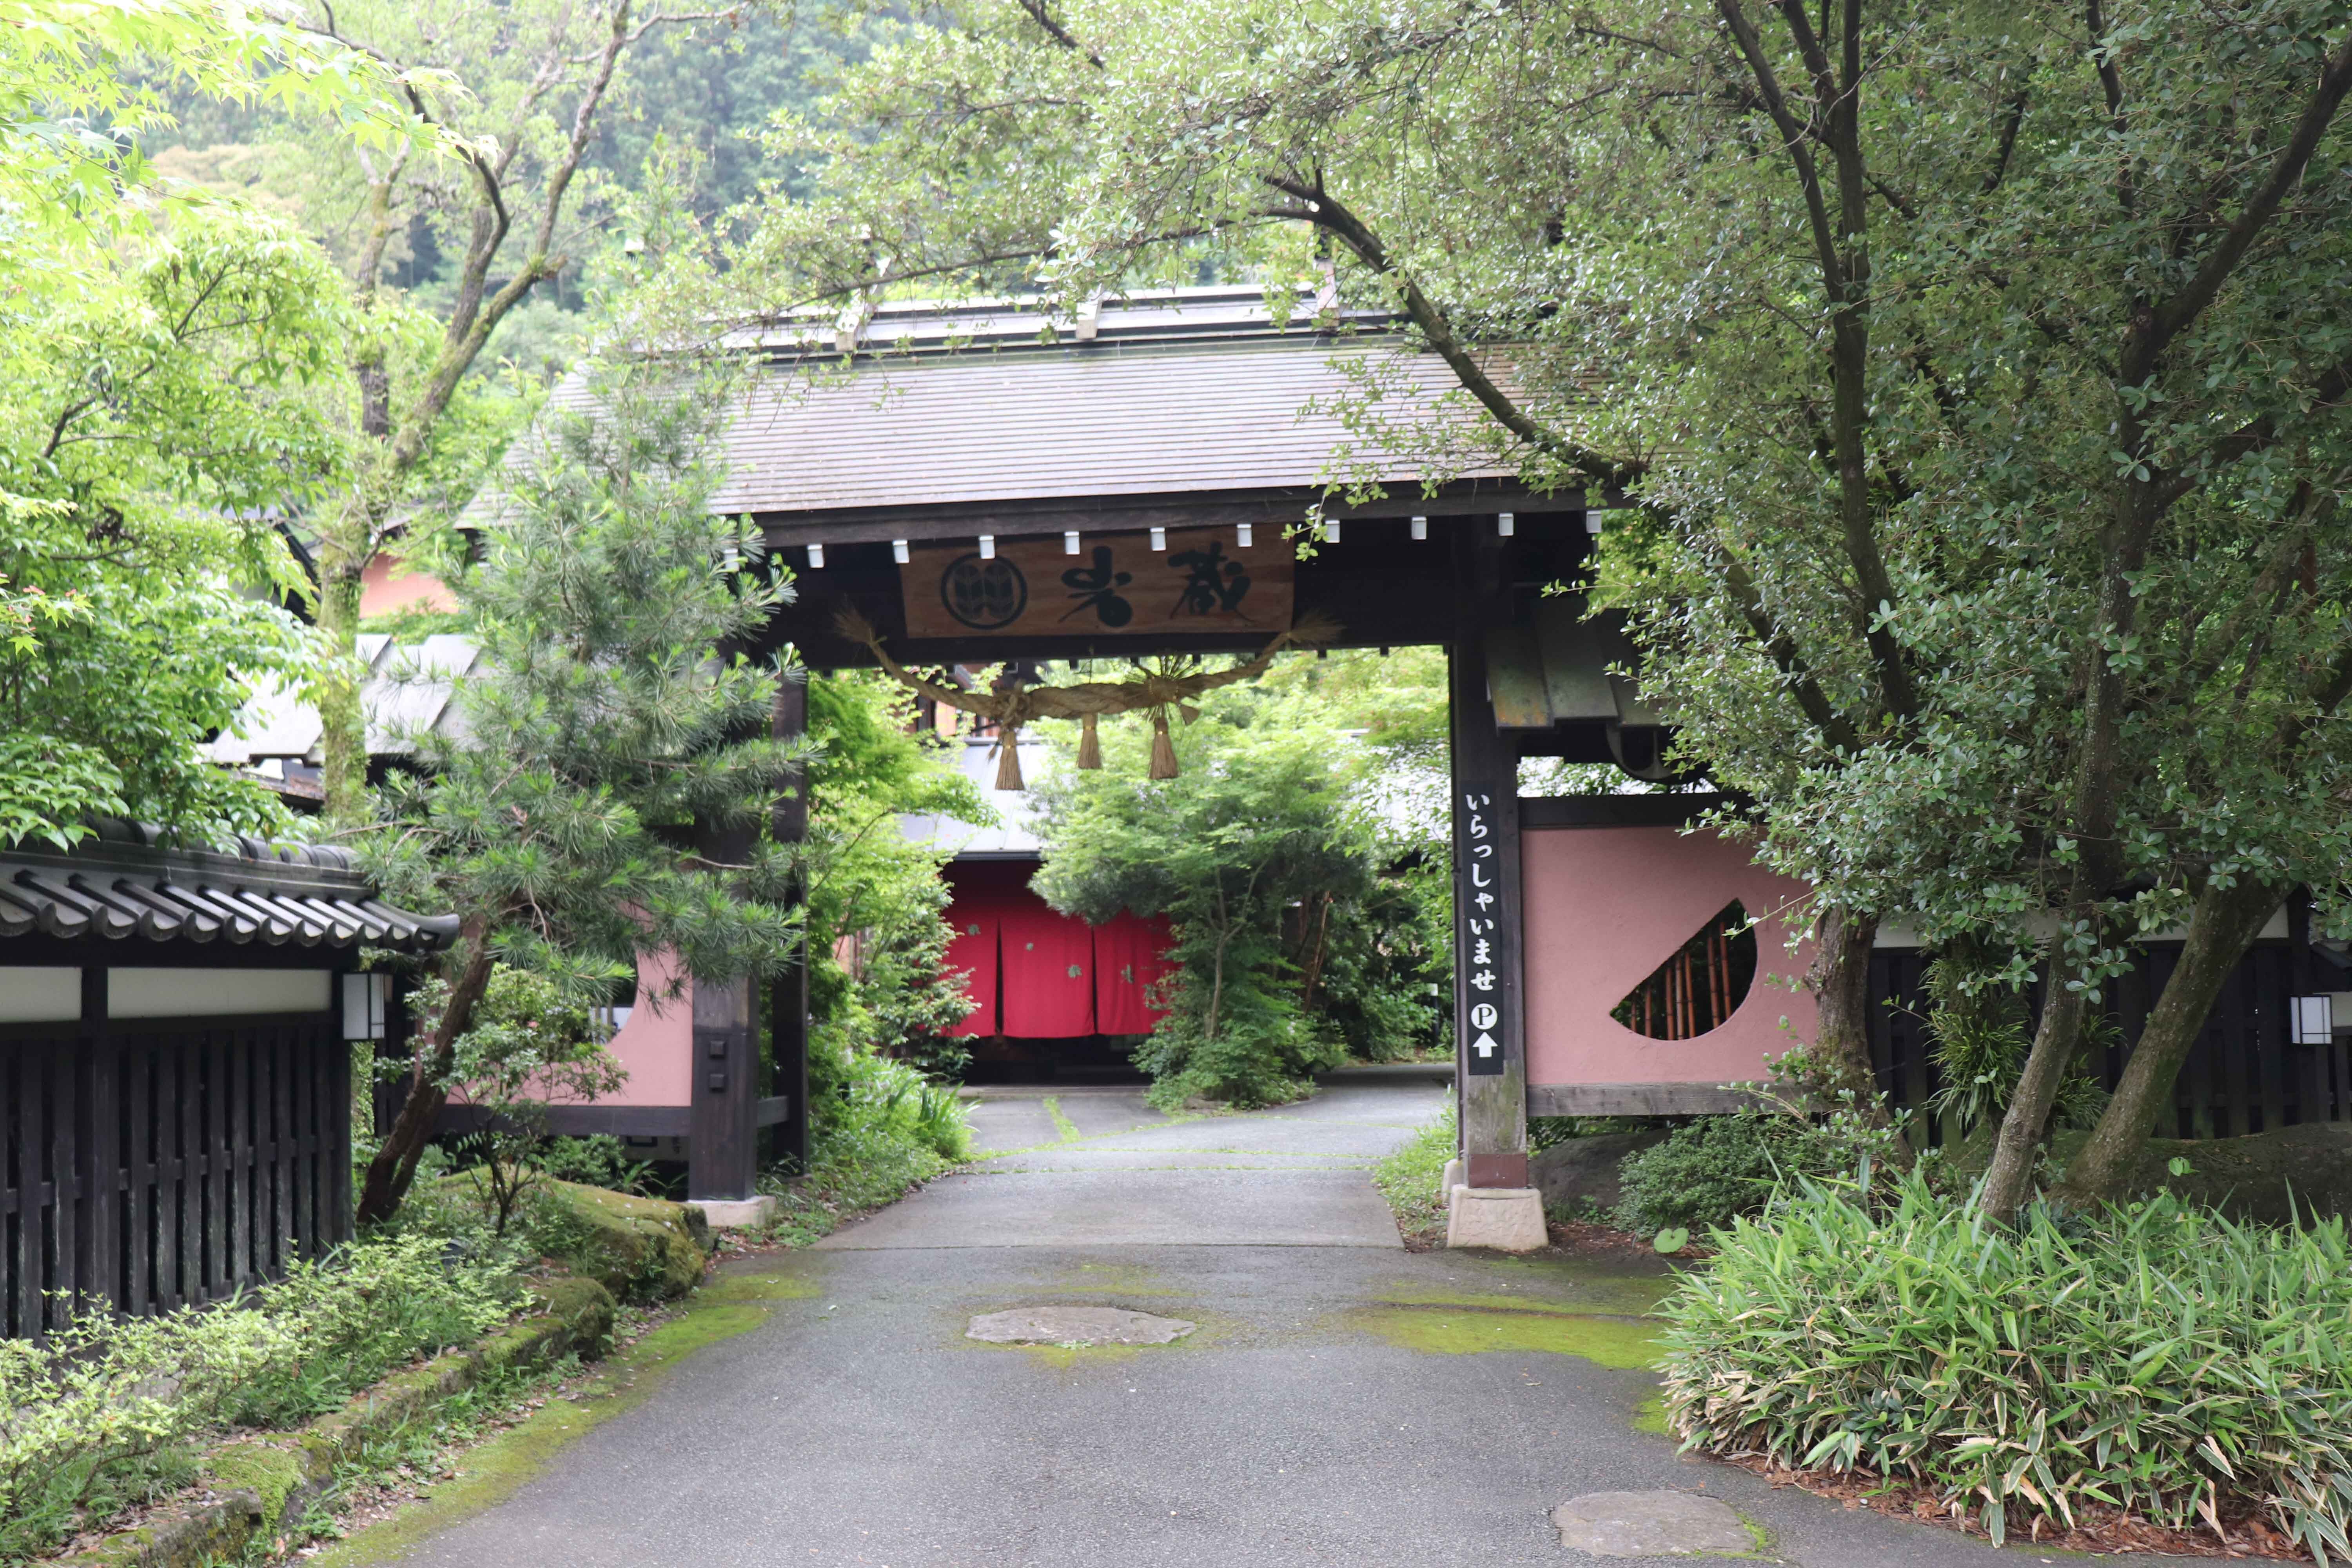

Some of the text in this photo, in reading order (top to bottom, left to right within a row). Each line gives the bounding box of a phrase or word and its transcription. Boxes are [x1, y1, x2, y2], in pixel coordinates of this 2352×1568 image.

[1465, 793, 1496, 1027] いらっしゃいませ P
